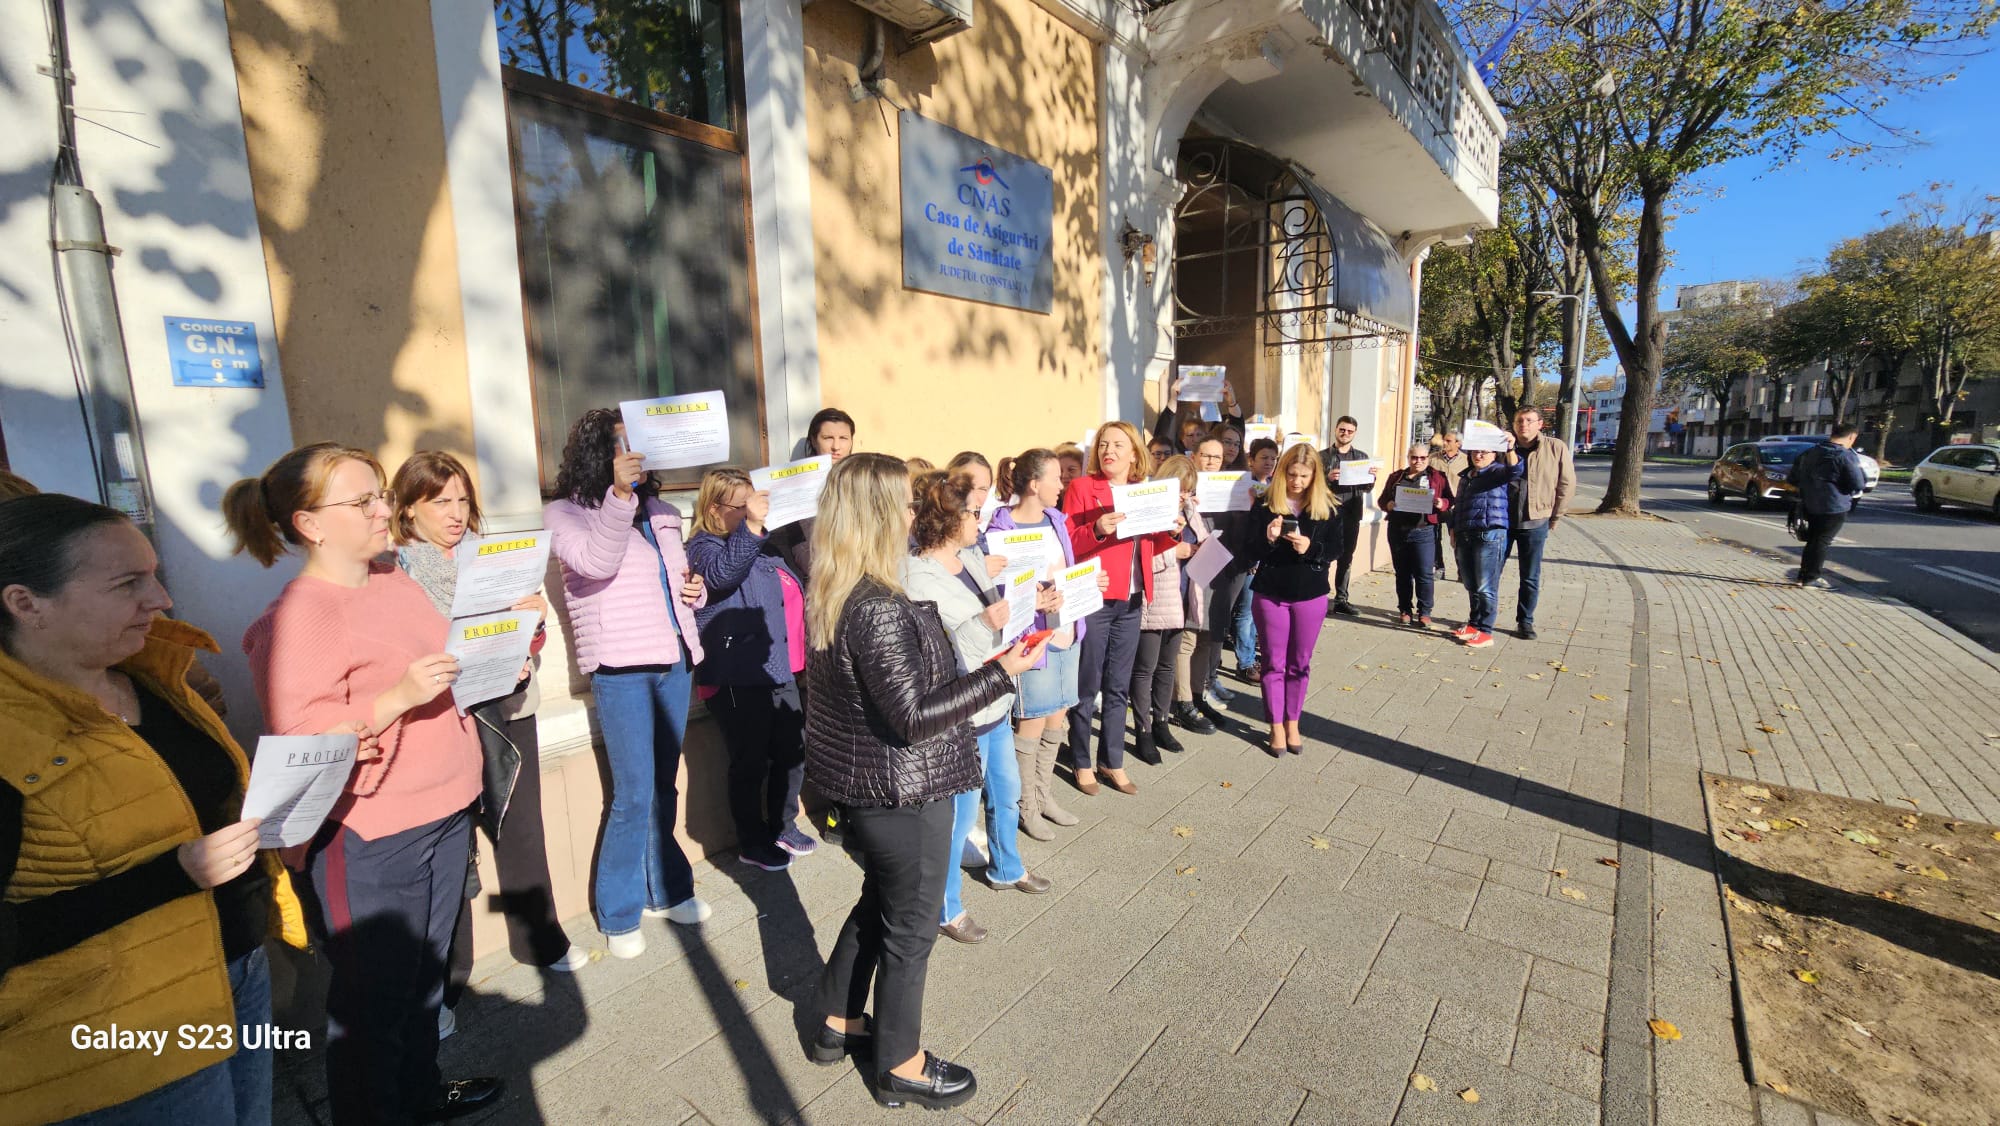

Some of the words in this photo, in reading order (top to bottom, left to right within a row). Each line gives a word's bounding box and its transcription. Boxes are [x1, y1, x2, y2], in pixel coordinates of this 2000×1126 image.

[957, 183, 1010, 217] CNAS
[924, 202, 960, 229] Casa
[964, 215, 979, 234] de
[982, 222, 1038, 250] Asigurări
[948, 238, 964, 257] de
[968, 241, 1021, 271] Sănătate
[180, 322, 245, 335] CONGAZ
[186, 334, 245, 356] G.N.
[211, 358, 223, 369] 6
[232, 360, 249, 369] m
[477, 538, 537, 556] PROTEST
[464, 621, 520, 640] PROTEST
